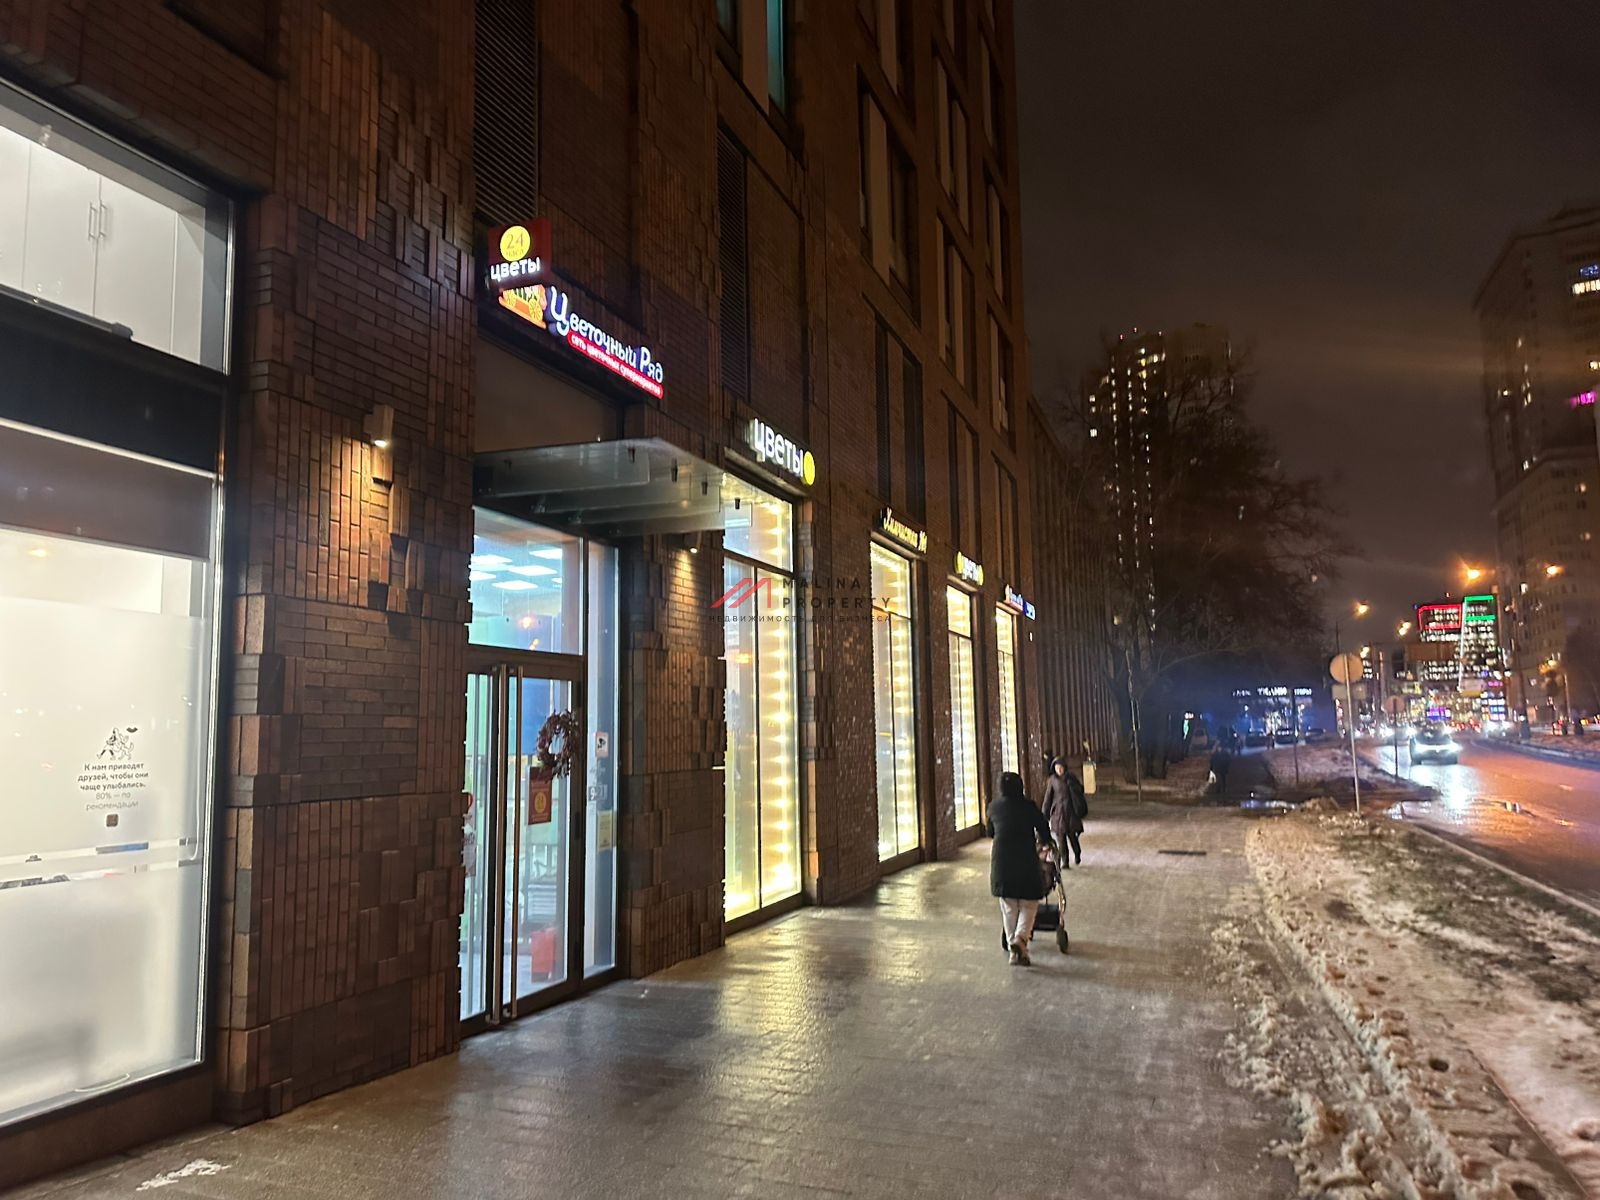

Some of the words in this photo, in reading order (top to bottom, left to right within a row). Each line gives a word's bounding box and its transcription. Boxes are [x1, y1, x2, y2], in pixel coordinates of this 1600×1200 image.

[506, 231, 524, 250] 24
[490, 256, 541, 282] цветы
[550, 285, 637, 369] Цветочный
[639, 346, 664, 384] Ряд
[753, 417, 804, 478] цветы
[108, 763, 144, 771] приводят
[77, 773, 109, 782] друзей,
[80, 783, 100, 791] чаще
[102, 782, 146, 791] улыбались.
[95, 792, 112, 800] 80%
[86, 801, 139, 811] рекомендации
